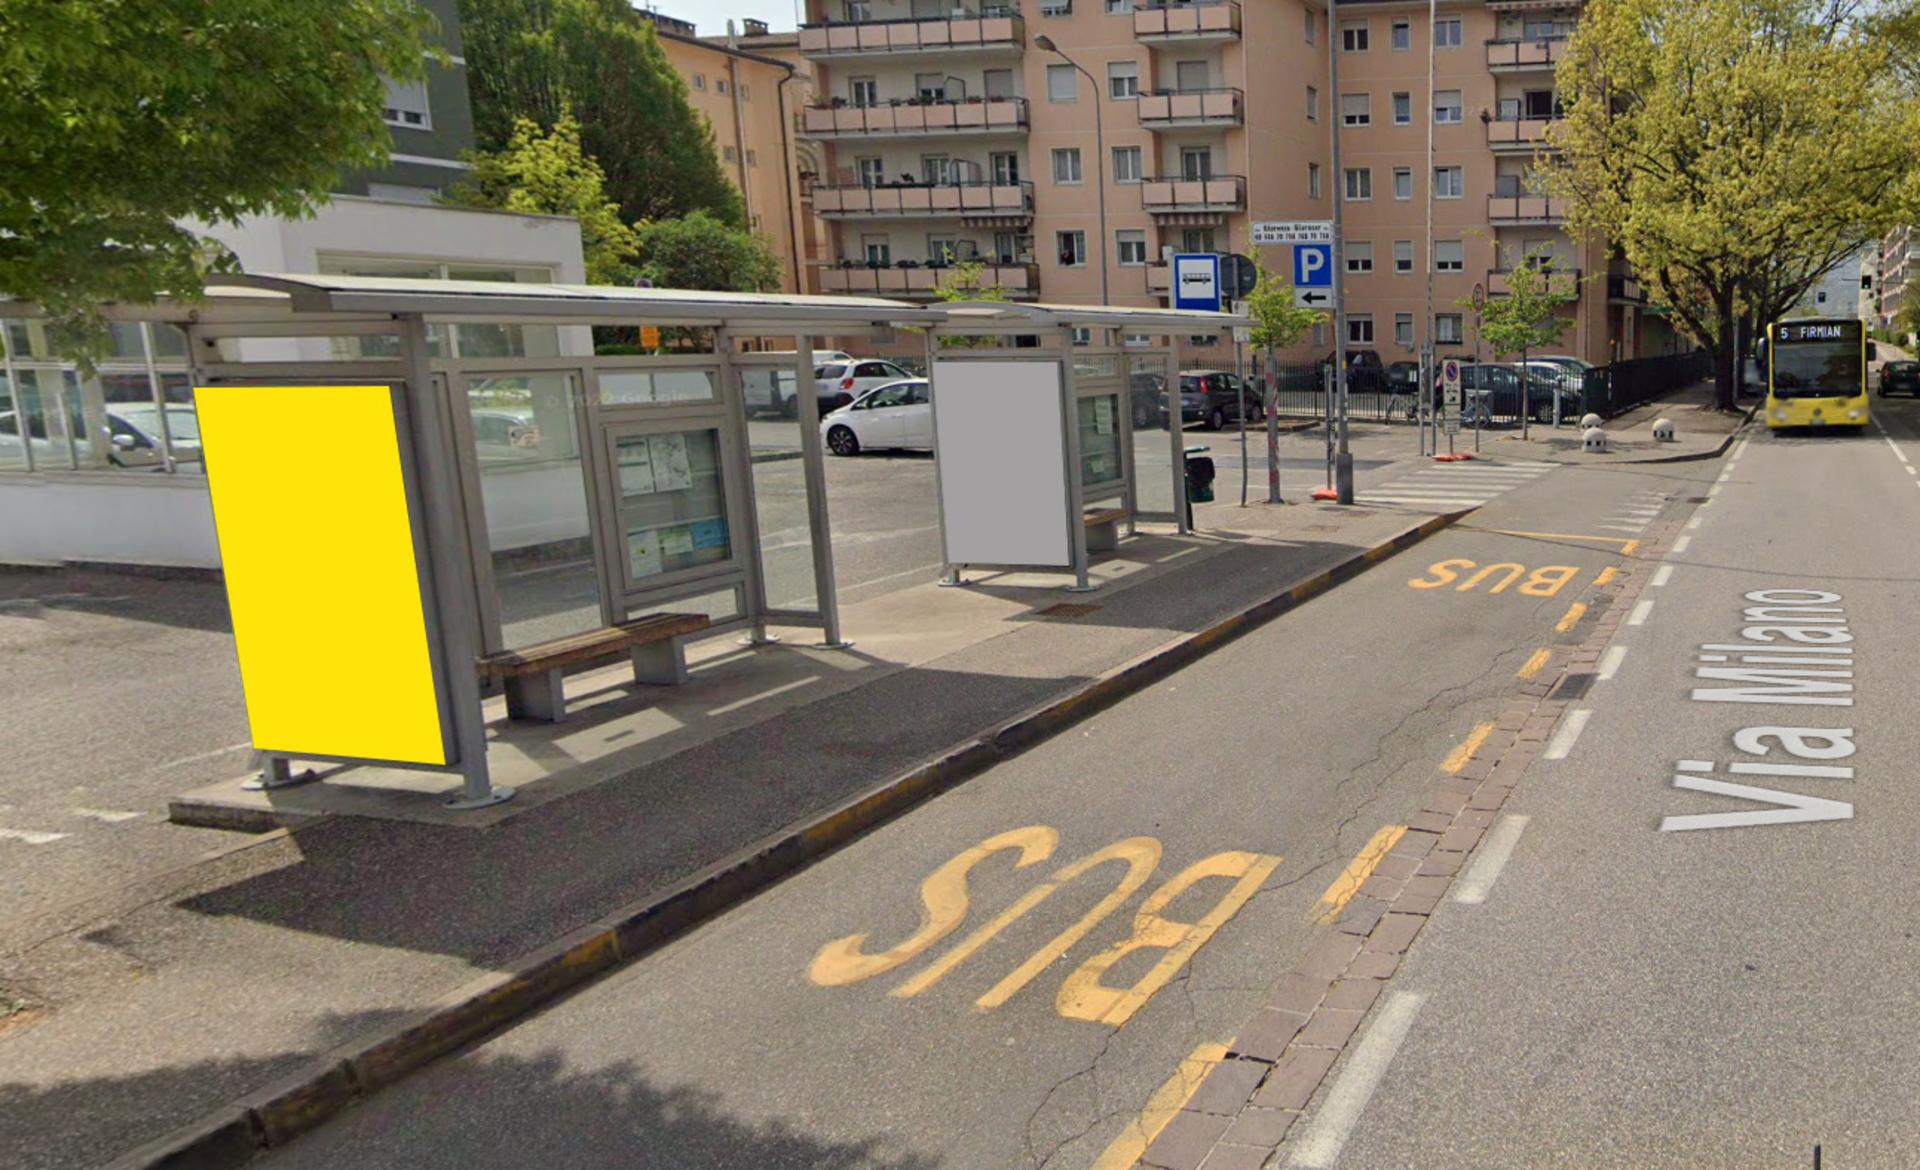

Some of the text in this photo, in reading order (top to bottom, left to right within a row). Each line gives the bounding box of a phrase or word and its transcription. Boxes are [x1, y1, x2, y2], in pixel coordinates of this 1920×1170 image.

[1300, 247, 1325, 283] P
[1780, 325, 1841, 340] 5 FIRMIAN
[1408, 558, 1581, 598] BUS
[808, 825, 1284, 1026] BUS
